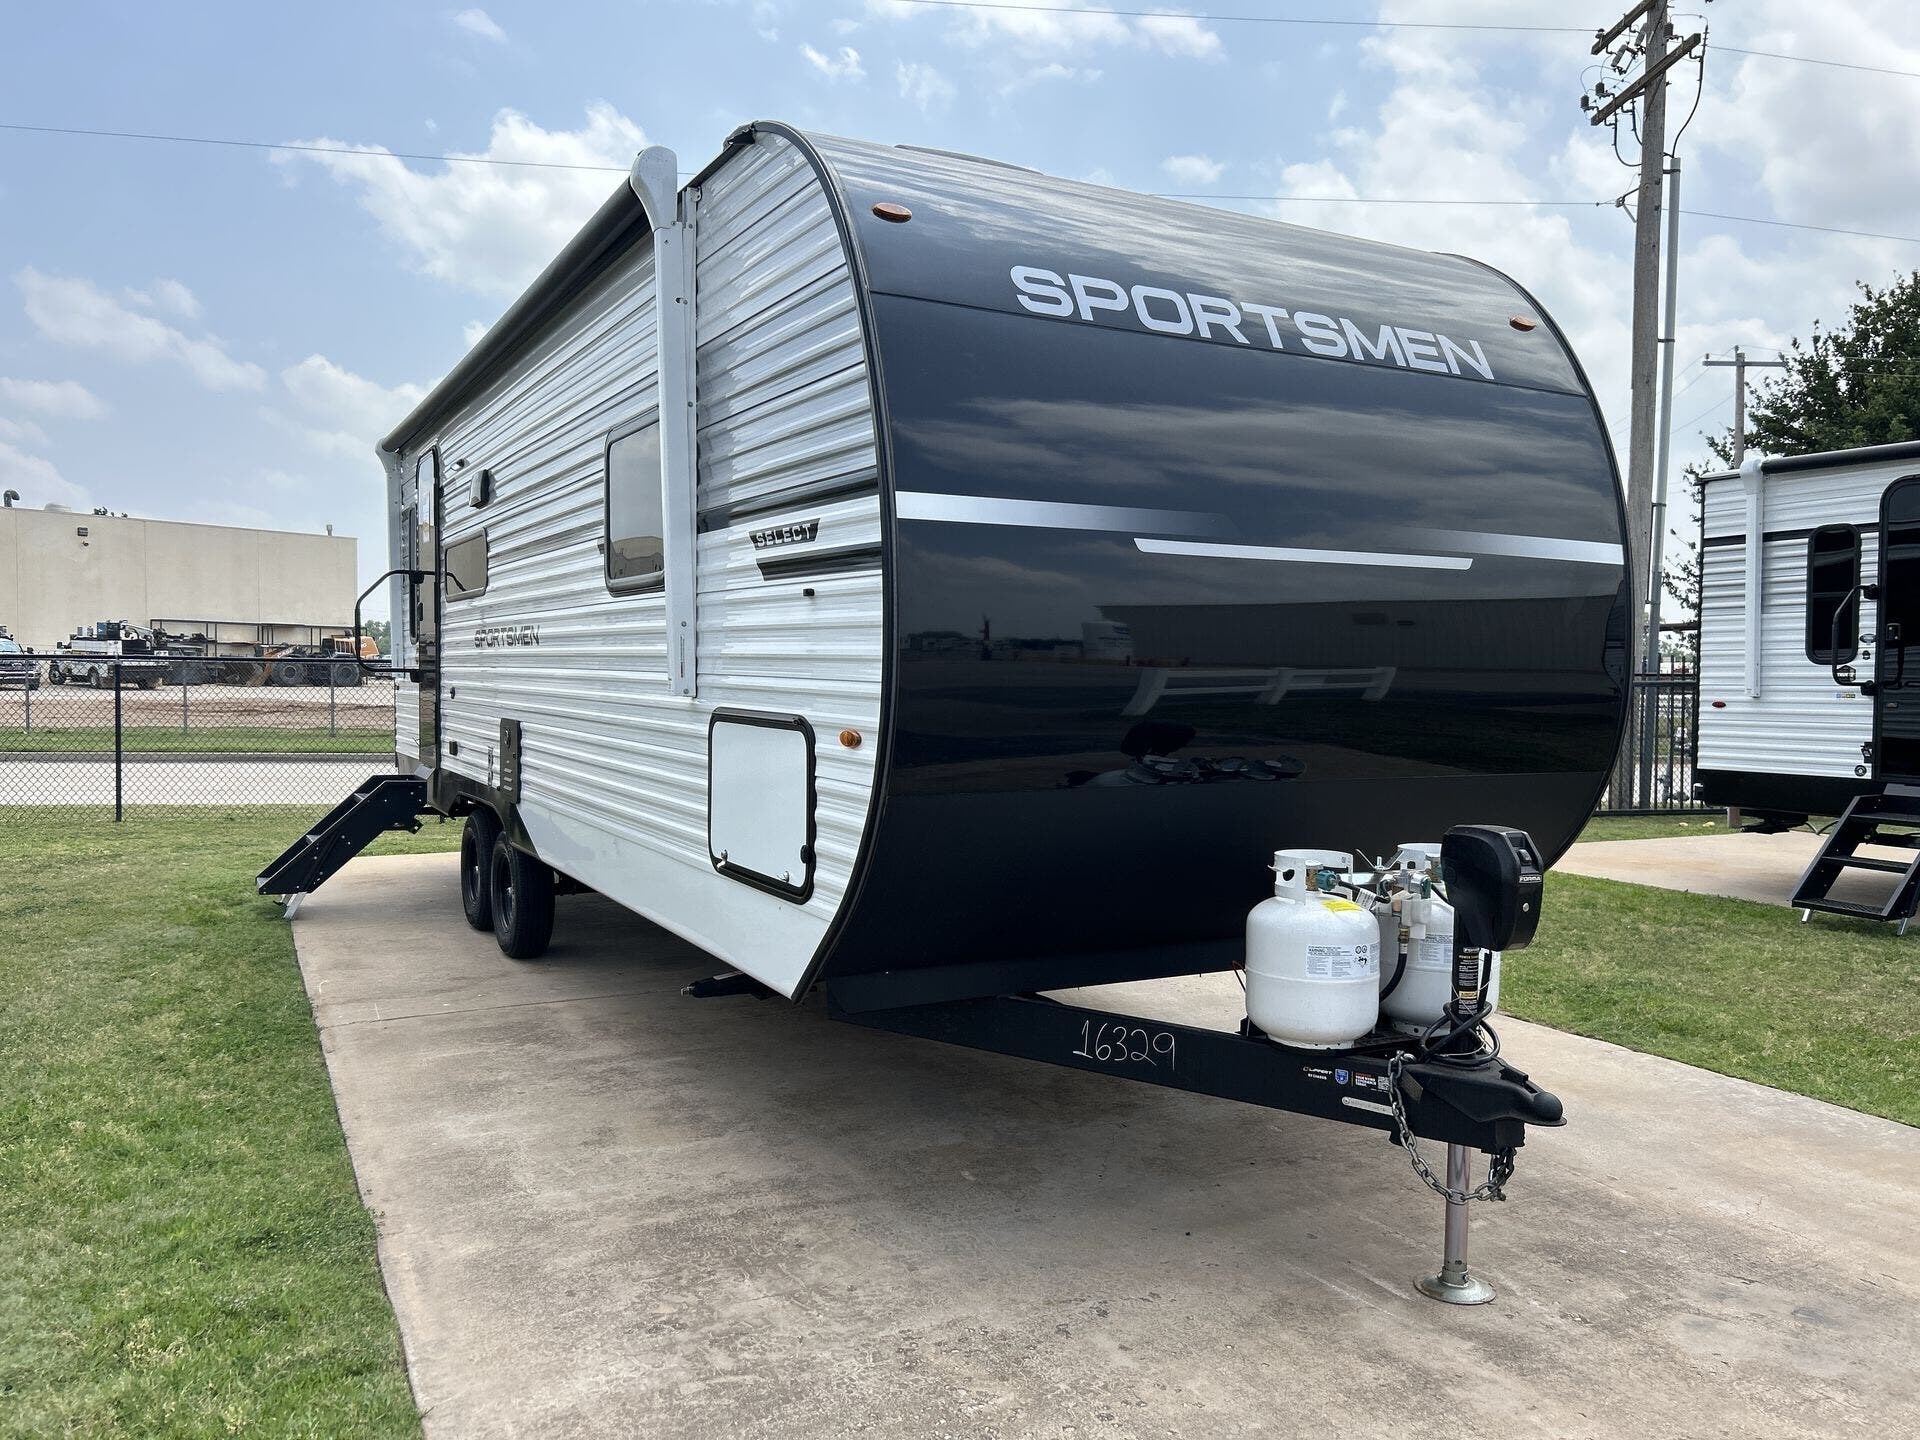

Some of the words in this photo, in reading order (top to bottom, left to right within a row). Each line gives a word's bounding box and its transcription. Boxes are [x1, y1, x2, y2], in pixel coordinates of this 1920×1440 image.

[1010, 265, 1494, 380] SPORTSMEN
[756, 523, 811, 547] SELECT
[474, 624, 540, 648] SPORTSMEN
[1073, 1020, 1175, 1072] 16329
